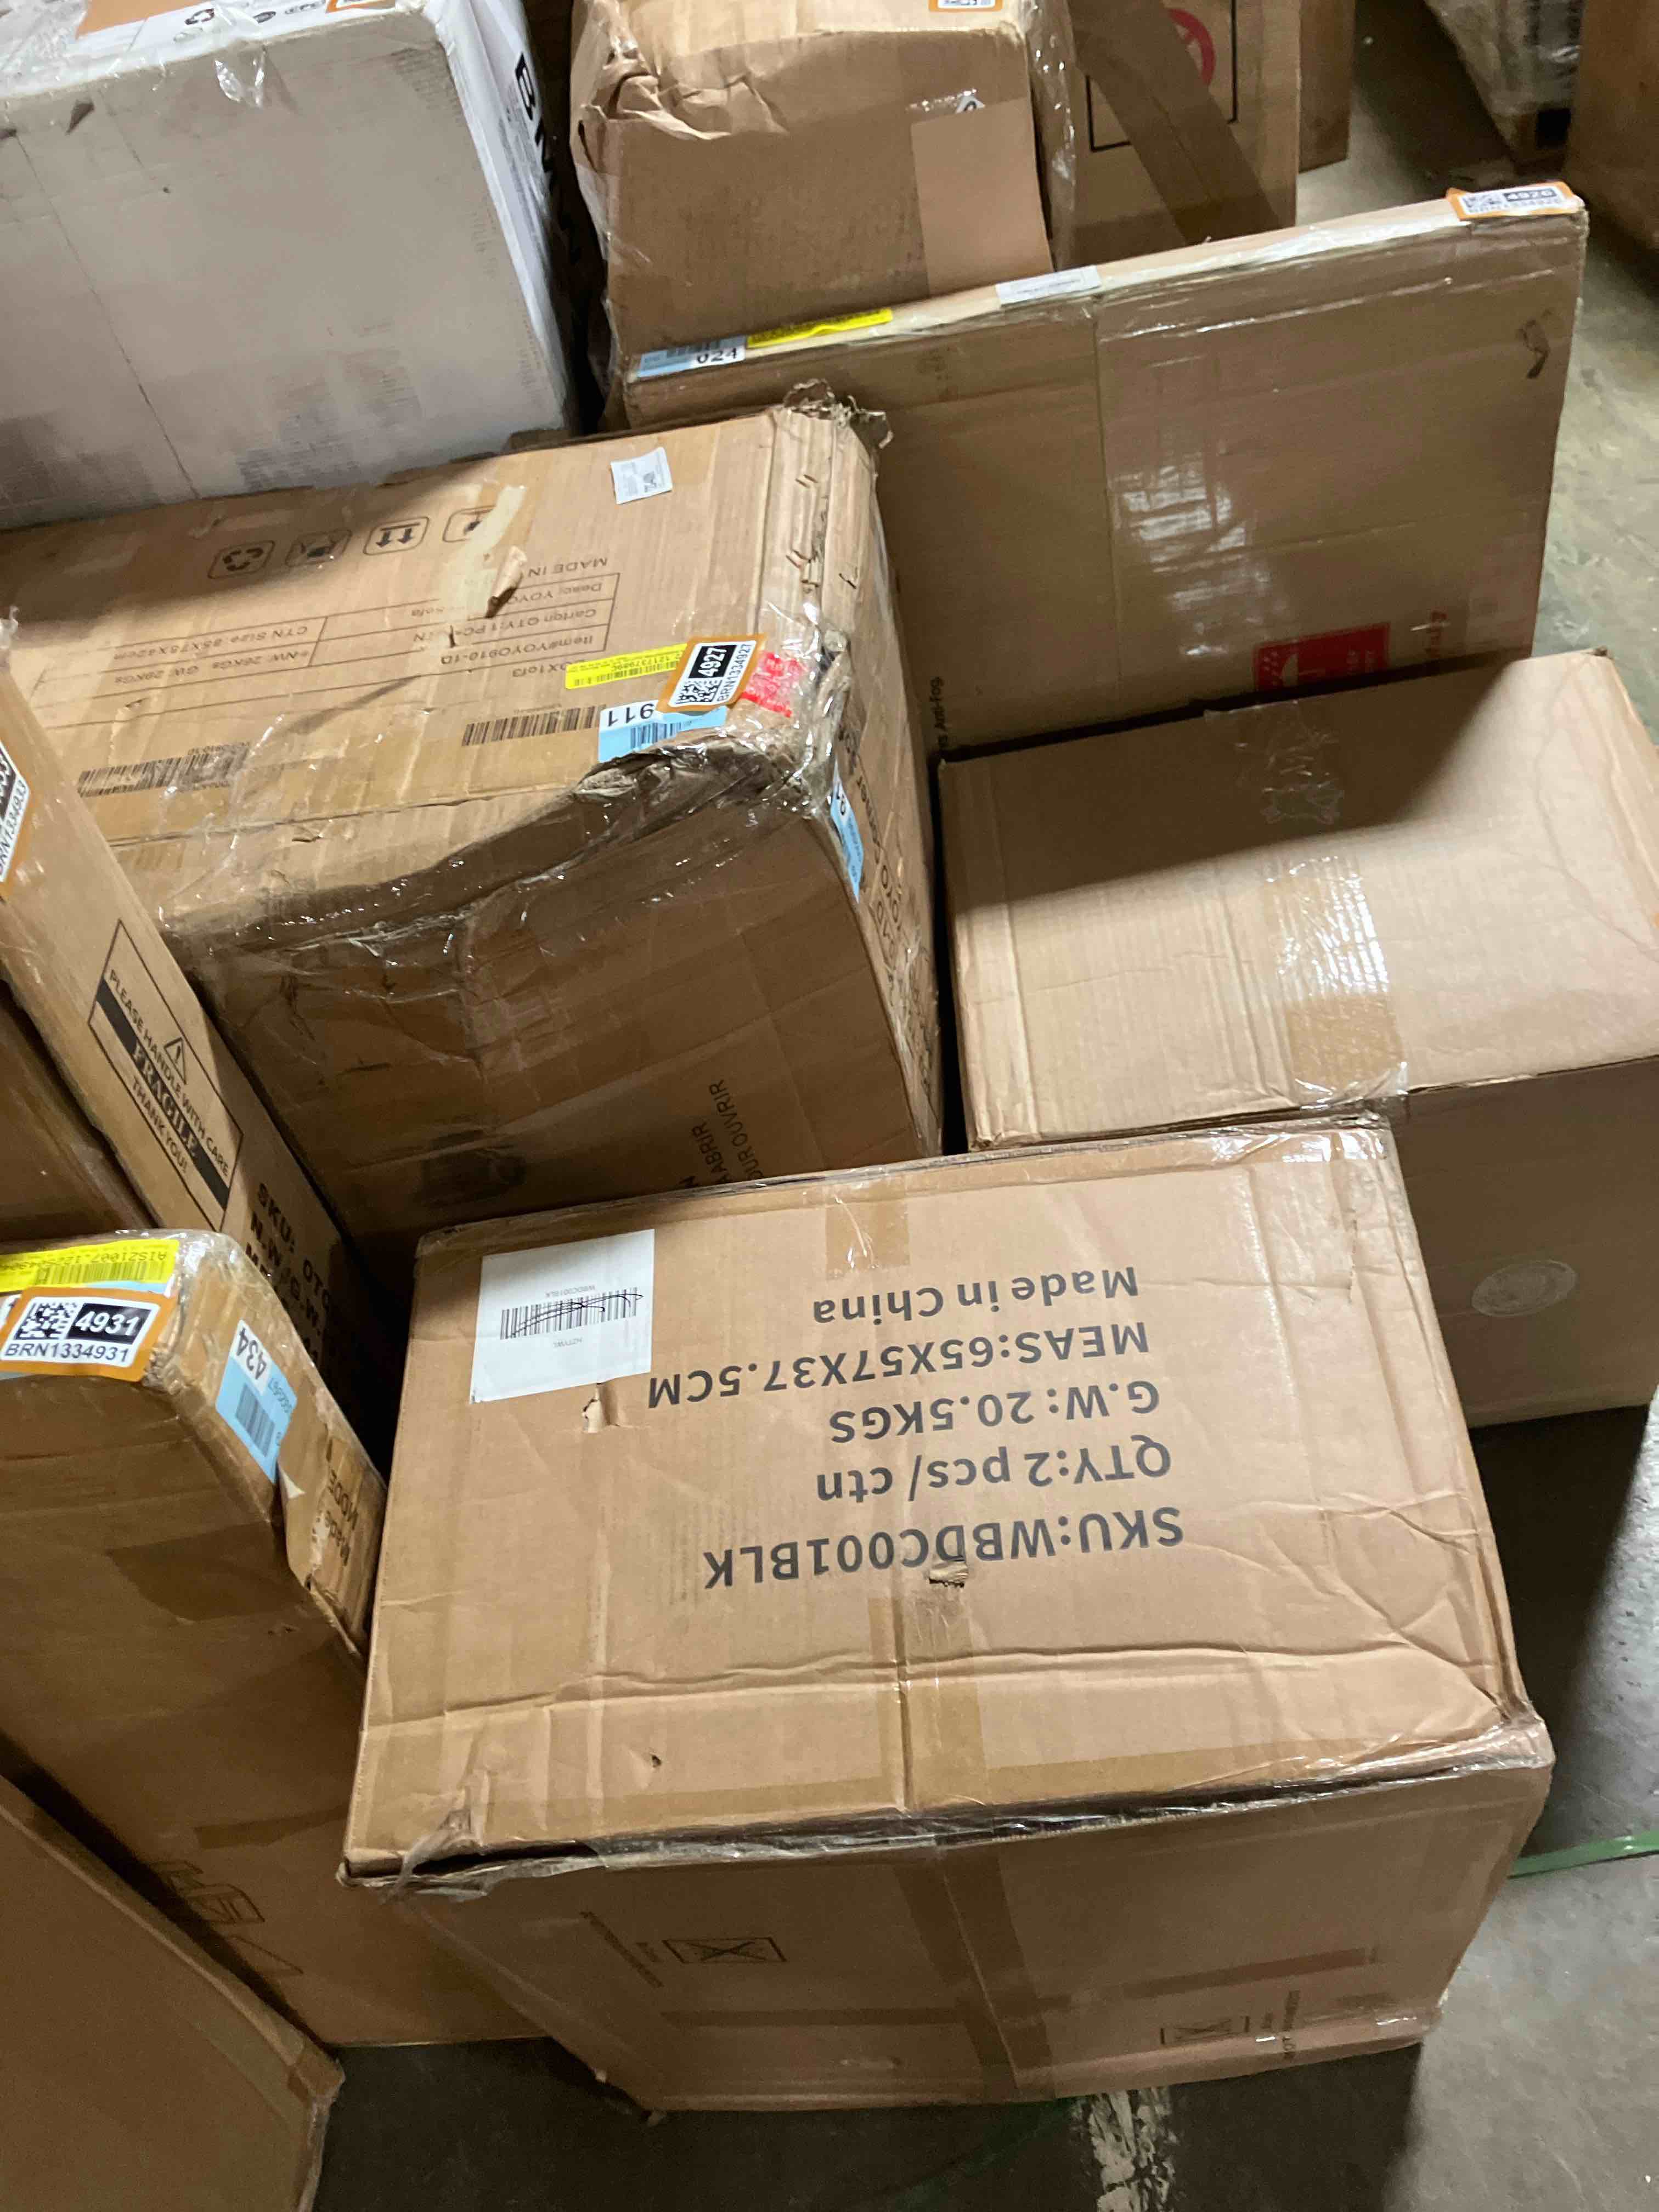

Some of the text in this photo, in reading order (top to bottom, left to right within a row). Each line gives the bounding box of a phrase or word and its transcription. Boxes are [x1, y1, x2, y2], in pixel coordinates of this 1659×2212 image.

[528, 557, 608, 578] MADE IN
[544, 608, 597, 622] Carton
[697, 645, 726, 678] 4927
[716, 643, 754, 702] BRN1334927
[606, 703, 654, 727] 911
[109, 969, 230, 1177] PLEASE HANDLE WITH CARE
[132, 1040, 199, 1156] FRAGILE
[132, 1075, 166, 1138] THANK
[709, 1080, 748, 1147] OUVRIR
[75, 1311, 140, 1336] 4931
[814, 1267, 1138, 1326] Made in China
[4, 1343, 129, 1363] BRN1334931
[236, 1327, 267, 1380] 434
[648, 1322, 1149, 1409] MEAS:65X57X37.5CM
[829, 1380, 1159, 1443] G.W: 20.5KGS
[817, 1435, 1171, 1503] QTY:2 pcs/ ctn
[703, 1506, 1183, 1589] SKU:WBDC001BLK
